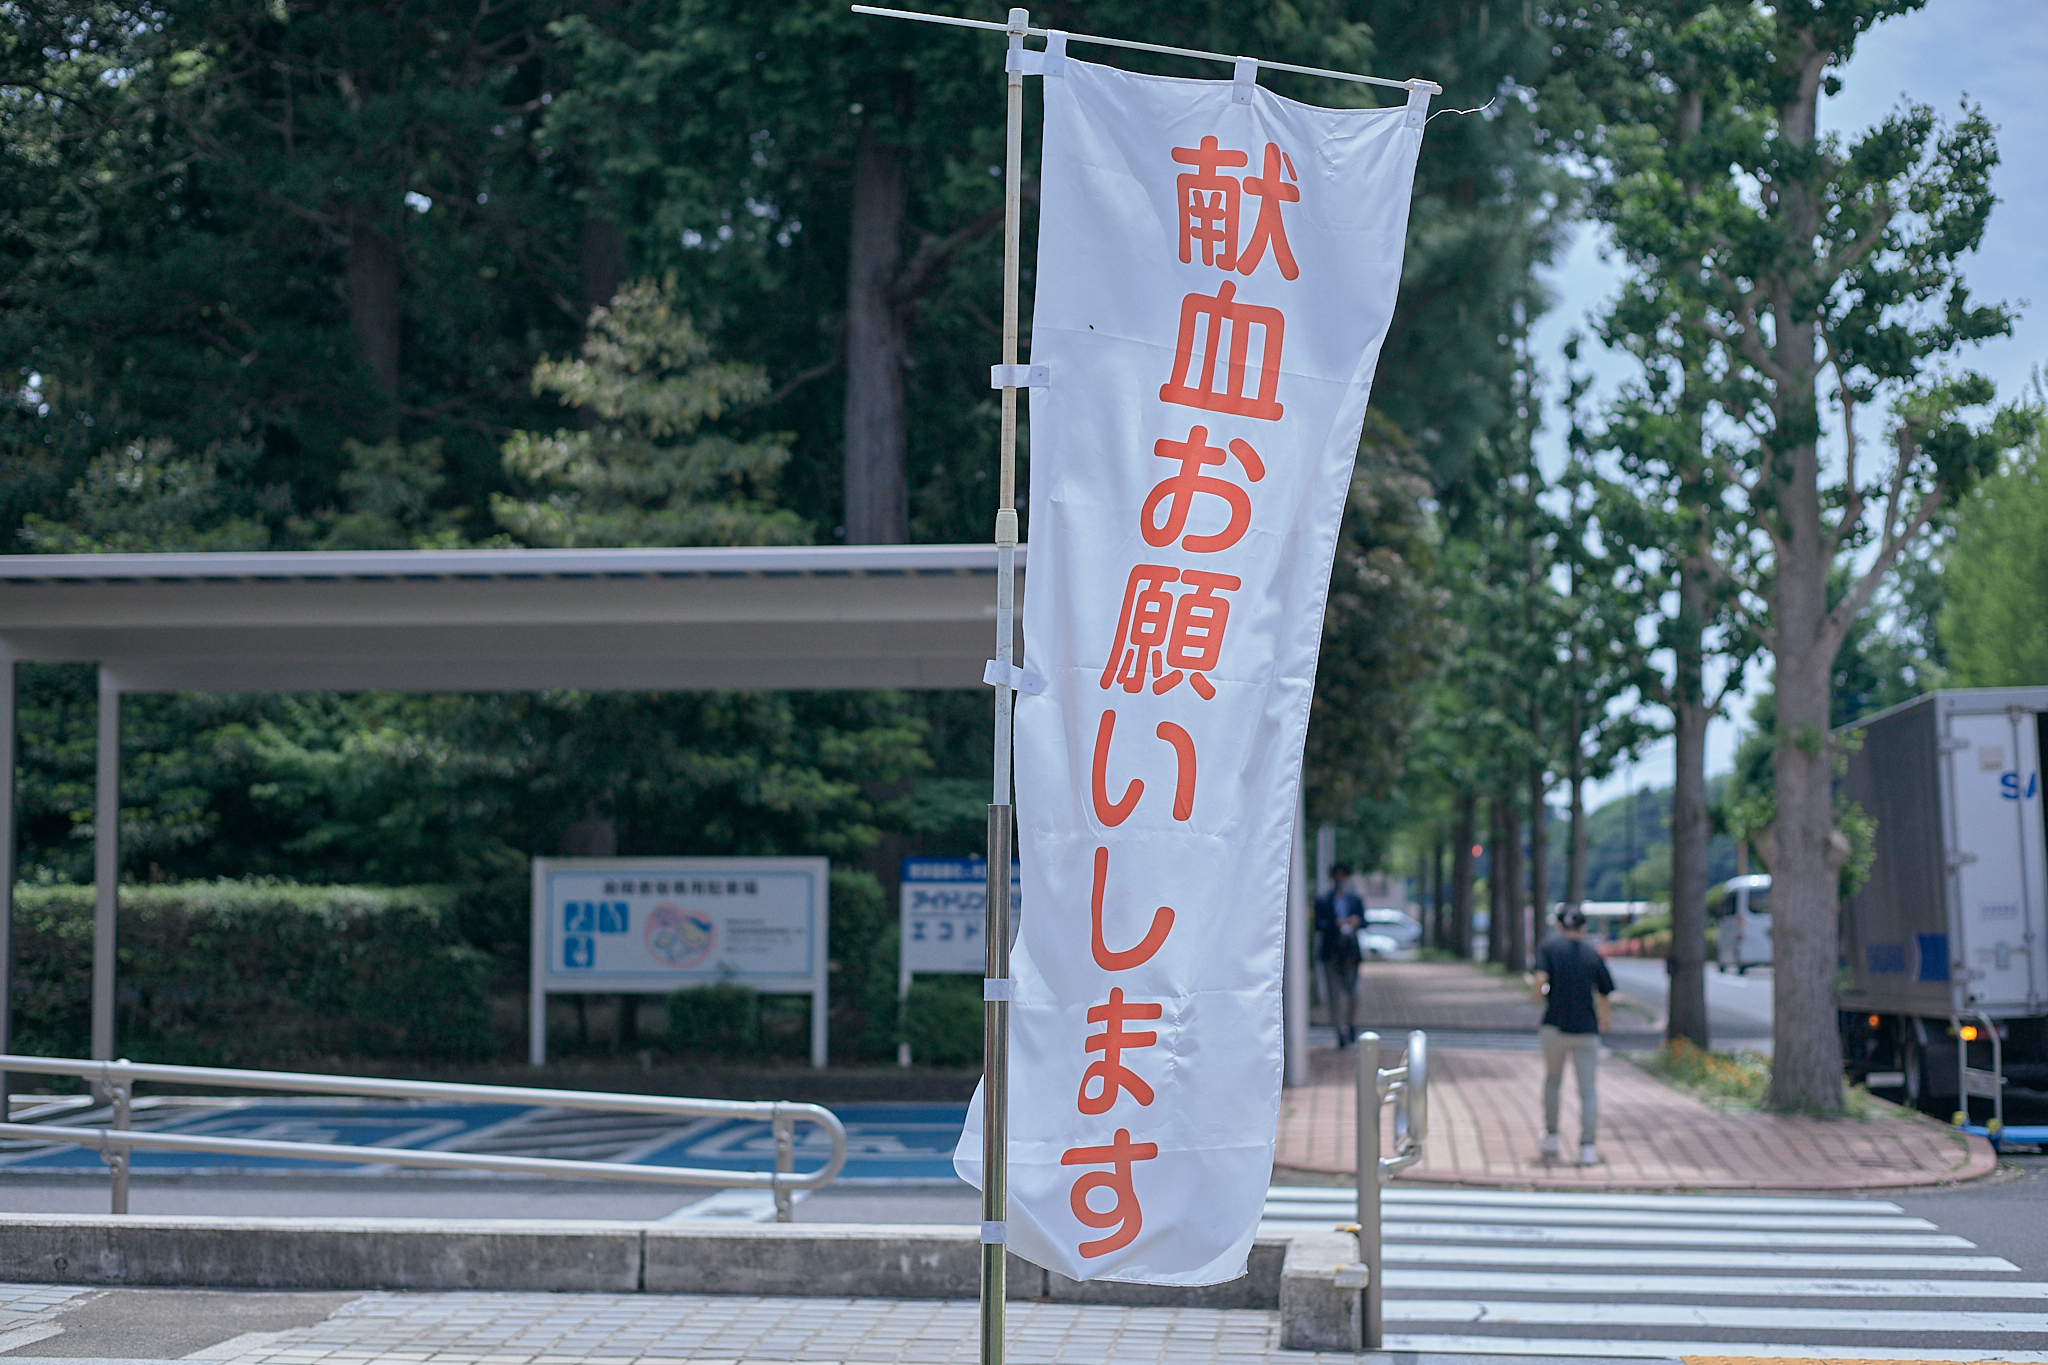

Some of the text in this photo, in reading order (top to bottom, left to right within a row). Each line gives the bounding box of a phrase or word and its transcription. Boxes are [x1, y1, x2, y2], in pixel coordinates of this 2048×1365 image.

[1060, 135, 1300, 1259] 献血お願いします
